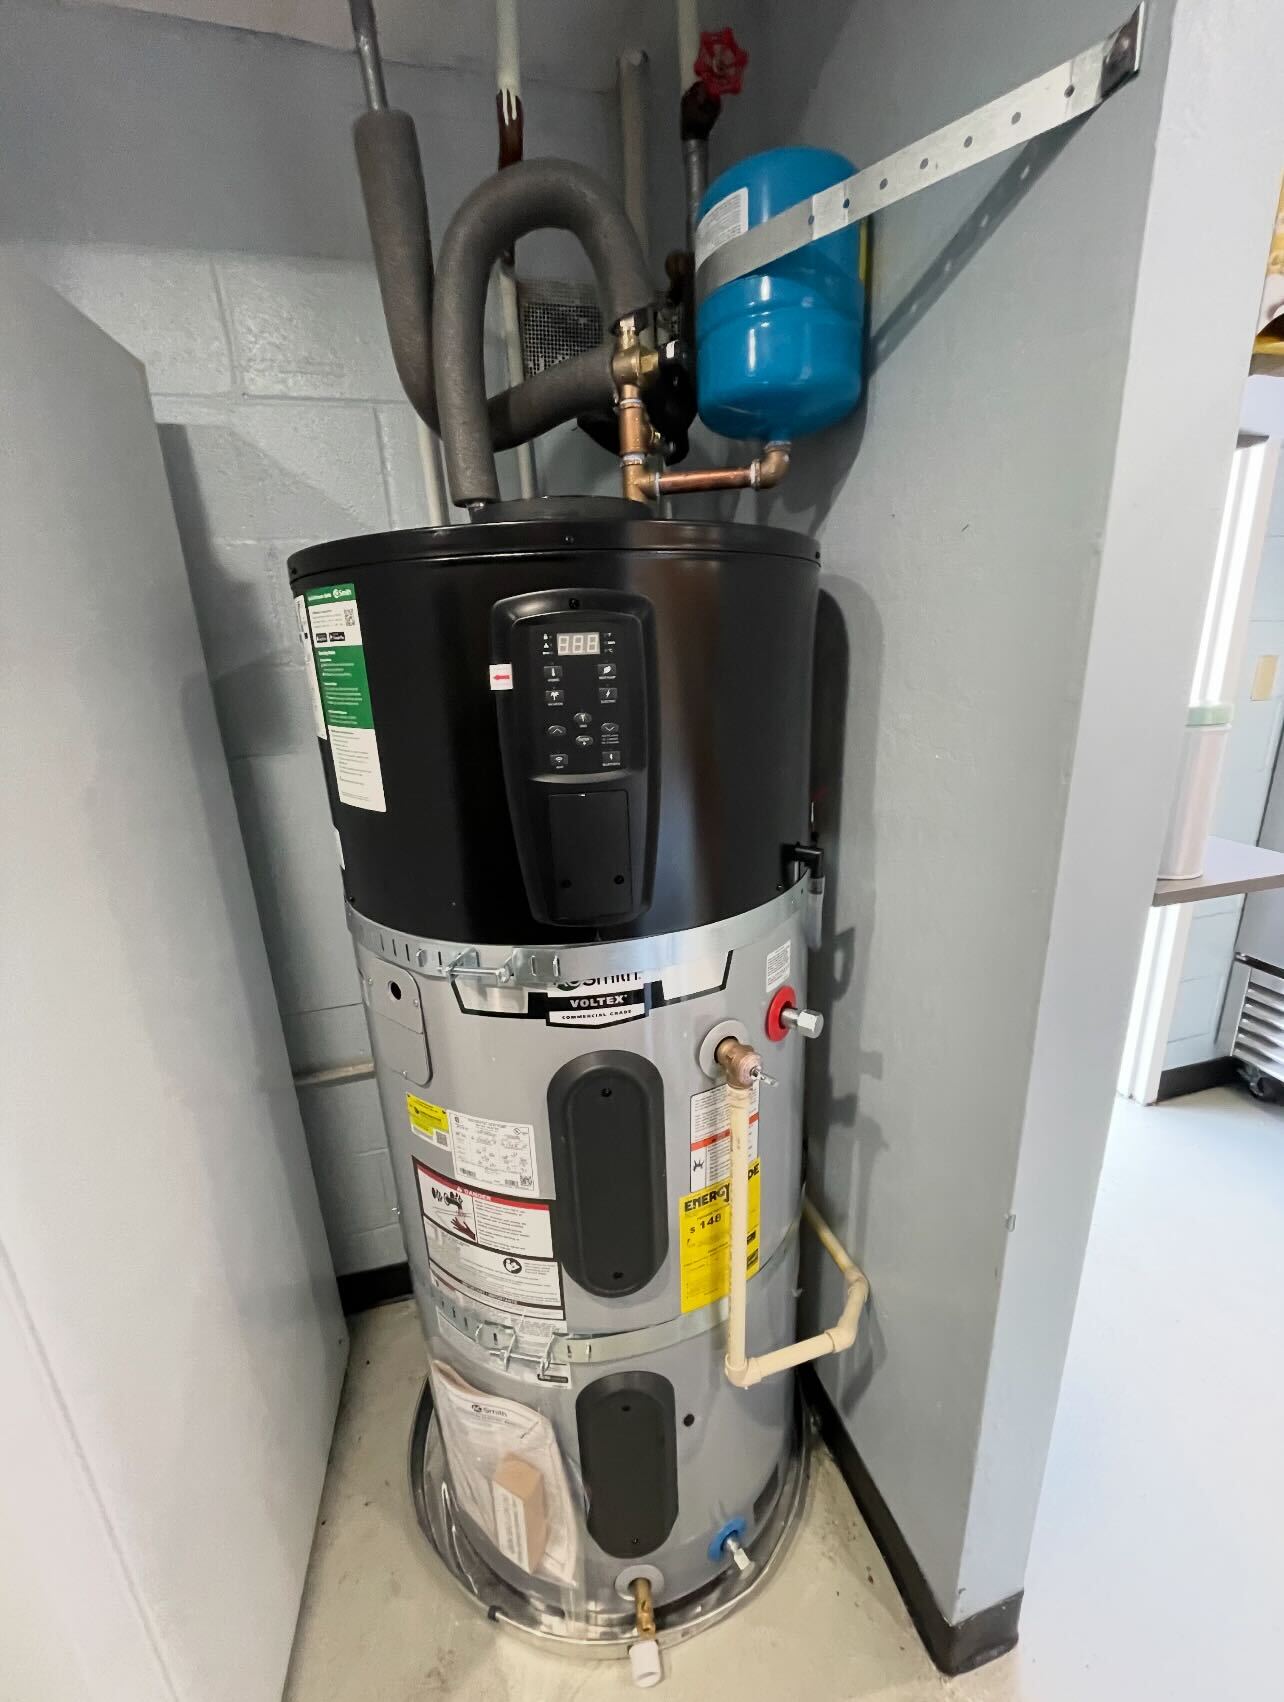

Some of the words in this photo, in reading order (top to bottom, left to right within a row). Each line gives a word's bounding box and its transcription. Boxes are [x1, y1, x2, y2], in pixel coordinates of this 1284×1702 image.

[569, 994, 625, 1008] VOLTEX
[561, 1012, 608, 1020] COMMERCIAL
[609, 1009, 632, 1017] GRADE
